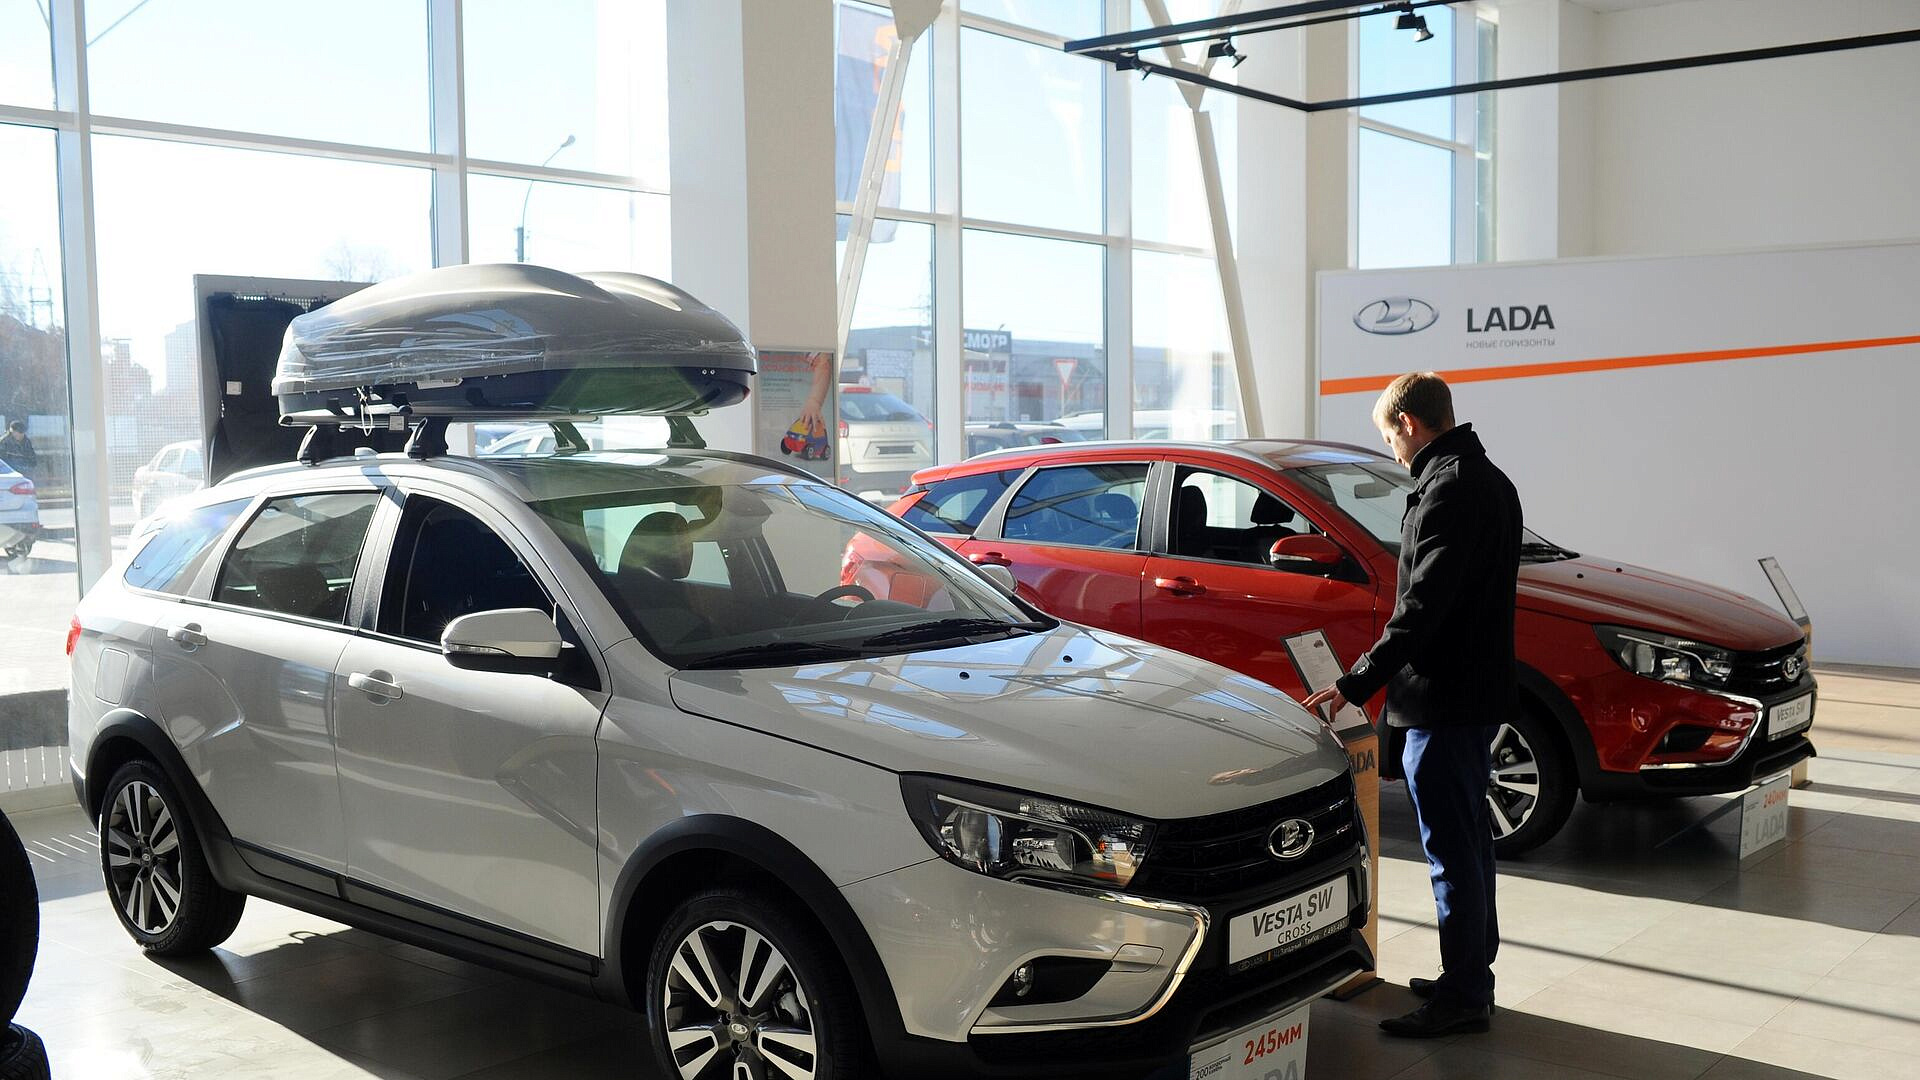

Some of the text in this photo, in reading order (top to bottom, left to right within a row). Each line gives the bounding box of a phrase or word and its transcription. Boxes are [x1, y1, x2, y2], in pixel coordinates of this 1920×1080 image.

[1467, 304, 1555, 333] LADA
[1465, 338, 1556, 349] НОВЫЕ ГОРИЗОНТЫ
[1756, 811, 1785, 844] LADA
[1252, 903, 1303, 938] VESTA
[1306, 886, 1334, 917] SW
[1277, 921, 1312, 944] CROSS
